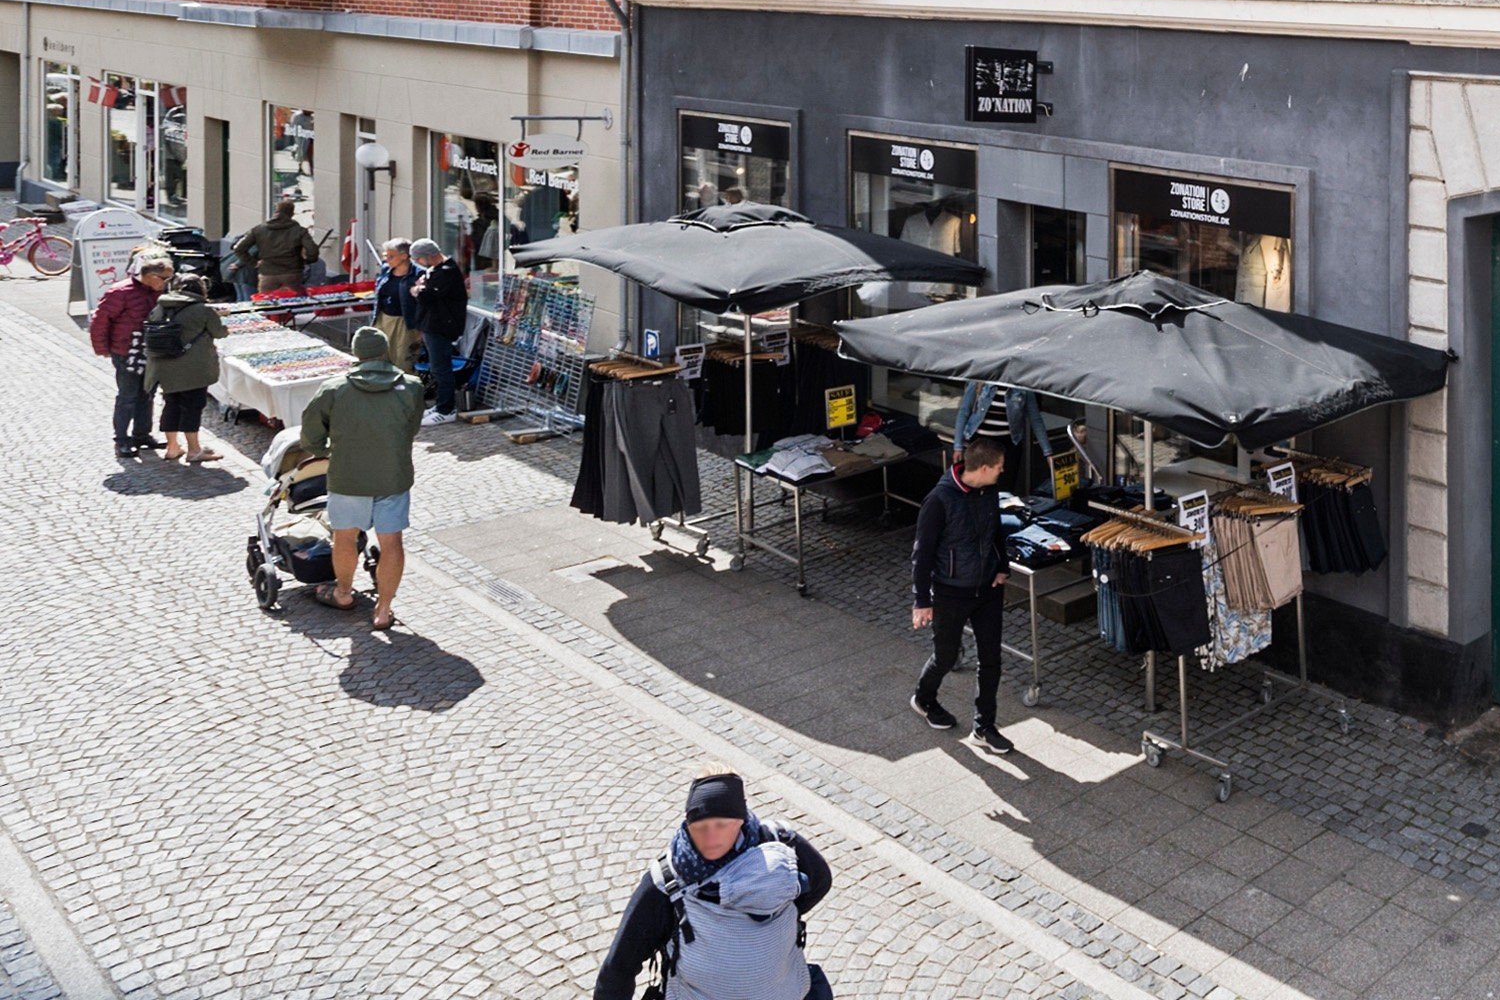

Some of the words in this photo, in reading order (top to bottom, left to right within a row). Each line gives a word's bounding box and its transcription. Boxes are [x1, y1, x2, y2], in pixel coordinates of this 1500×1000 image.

[978, 96, 1033, 113] ZO'NATION
[531, 148, 550, 156] Red
[552, 148, 584, 156] Barnet
[453, 153, 469, 170] Red
[470, 156, 498, 176] Barnet
[529, 168, 546, 186] Red
[1170, 181, 1206, 199] ZONATION
[1182, 196, 1206, 212] STORE
[1170, 208, 1230, 226] ZONATIONSTORE.DK
